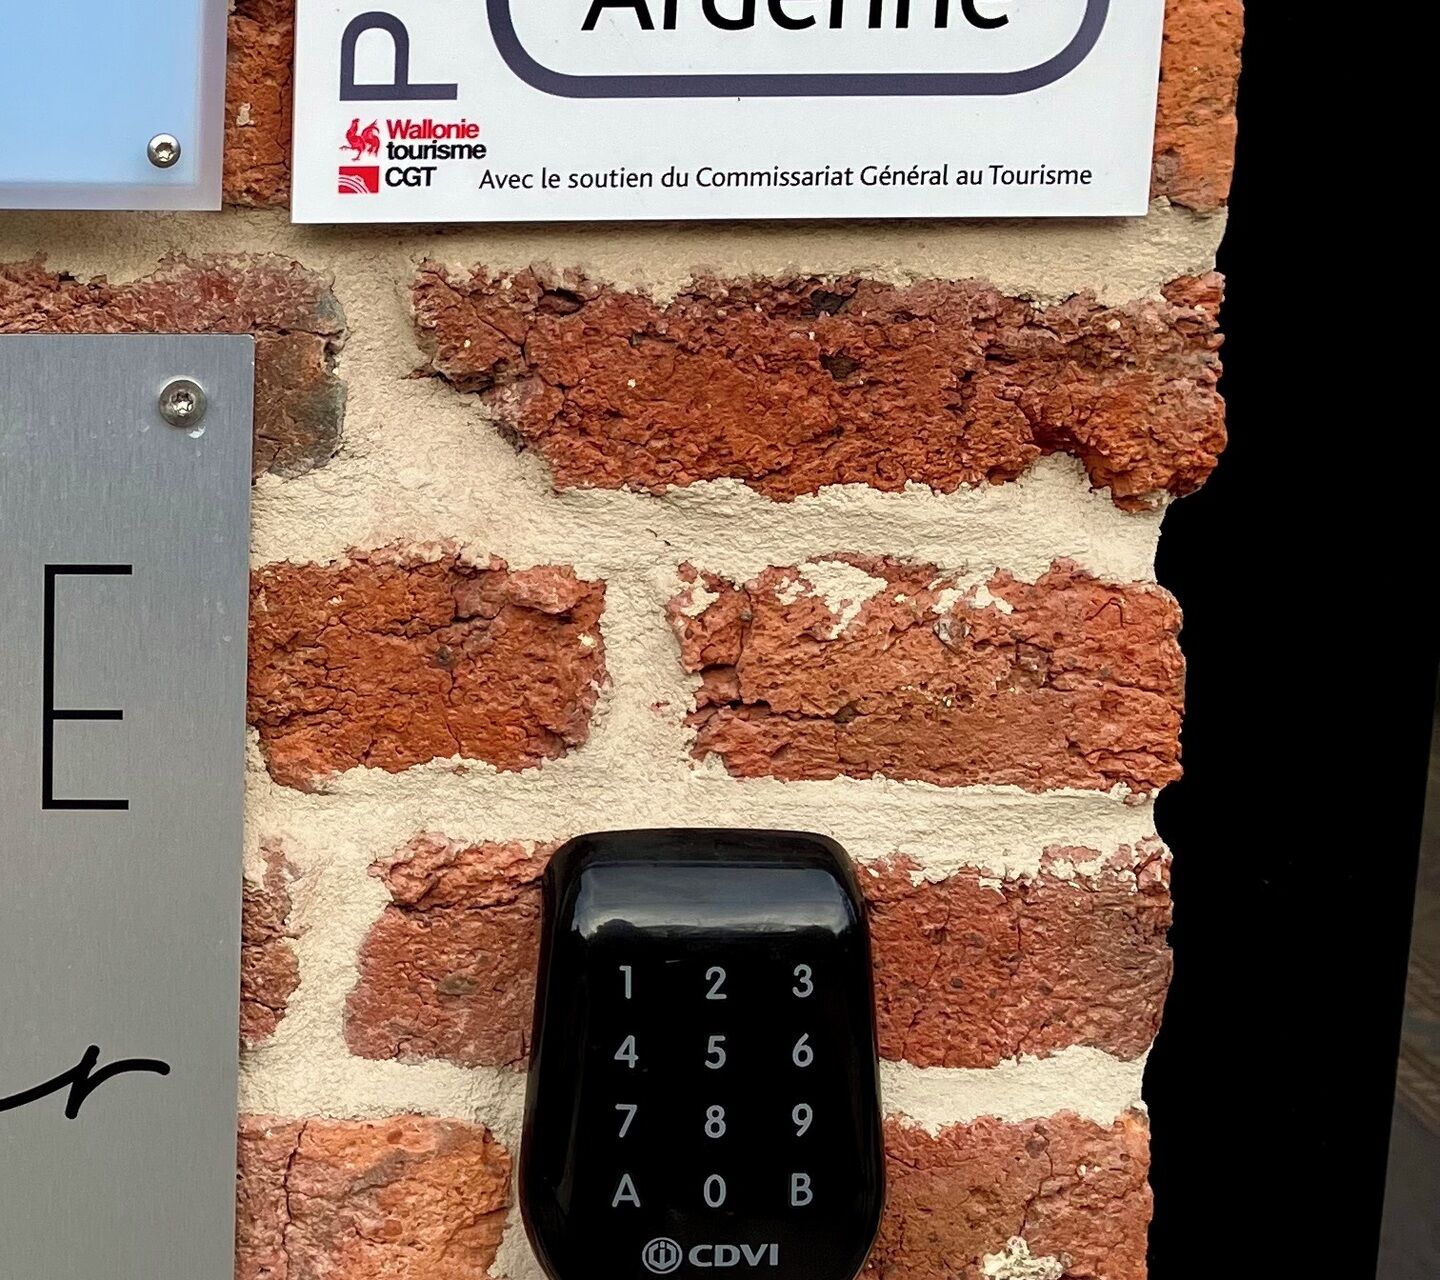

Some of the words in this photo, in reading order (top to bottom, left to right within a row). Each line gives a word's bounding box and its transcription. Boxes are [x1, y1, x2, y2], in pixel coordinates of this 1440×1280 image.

[385, 118, 480, 140] Wallonie
[385, 139, 487, 161] tourisme
[384, 166, 438, 188] CGT
[478, 168, 534, 190] Avec
[541, 166, 561, 189] le
[567, 166, 653, 189] soutien
[660, 165, 689, 188] du
[695, 164, 855, 188] Commissariat
[860, 163, 949, 186] Général
[955, 170, 983, 186] au
[988, 163, 1093, 186] Tourisme
[619, 965, 632, 1000] 1
[705, 966, 727, 1000] 2
[792, 963, 814, 998] 3
[613, 1034, 639, 1069] 4
[704, 1035, 727, 1070] 5
[792, 1032, 814, 1068] 6
[614, 1103, 638, 1138] 7
[704, 1104, 727, 1139] 8
[791, 1102, 813, 1137] 9
[611, 1173, 641, 1208] A
[703, 1173, 727, 1208] 0
[790, 1172, 814, 1207] B
[688, 1243, 779, 1268] CDVI
